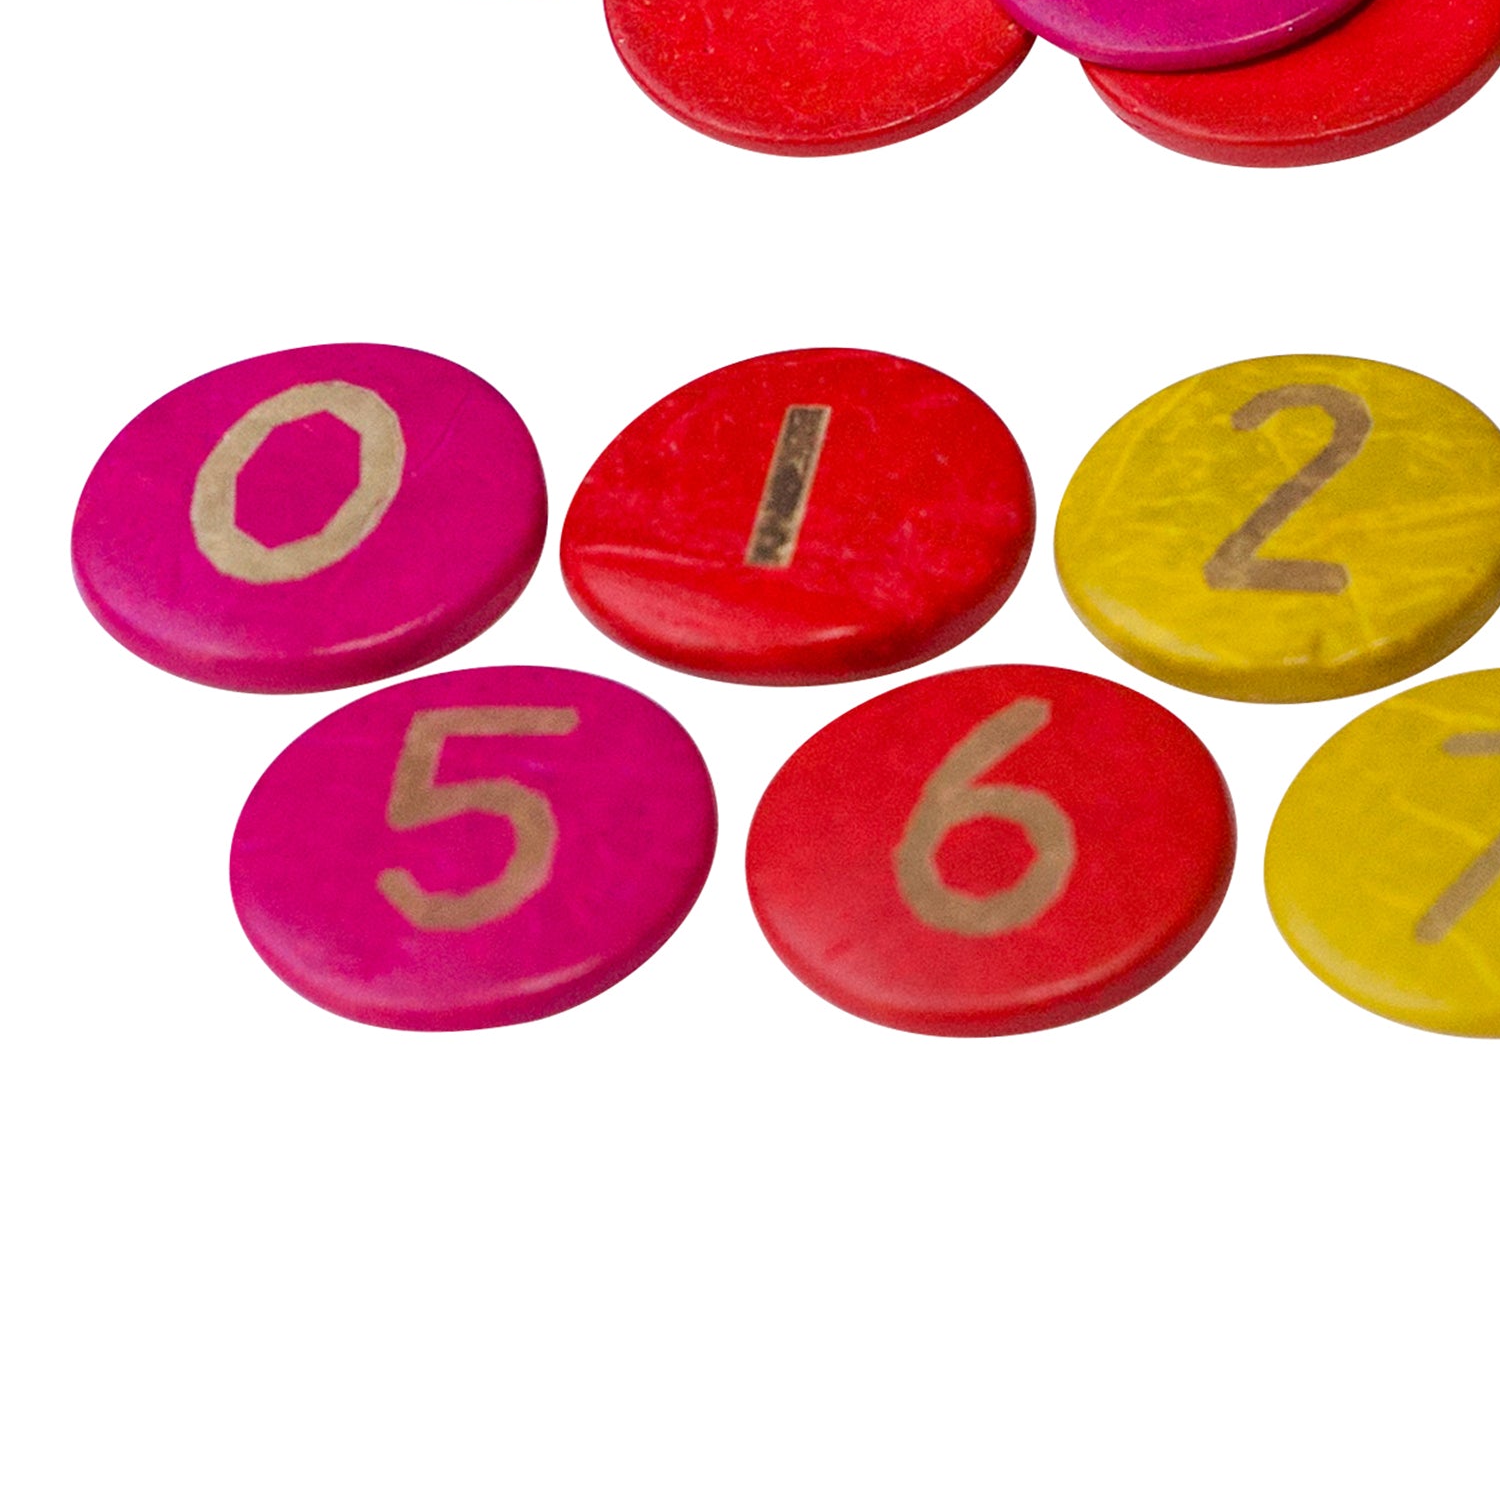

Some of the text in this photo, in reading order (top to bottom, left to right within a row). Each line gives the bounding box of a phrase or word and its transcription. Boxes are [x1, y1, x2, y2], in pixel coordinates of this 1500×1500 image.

[190, 380, 406, 585] 0
[743, 404, 832, 569] 1
[1203, 383, 1372, 596] 2
[375, 706, 580, 932] 5
[893, 697, 1076, 937] 6
